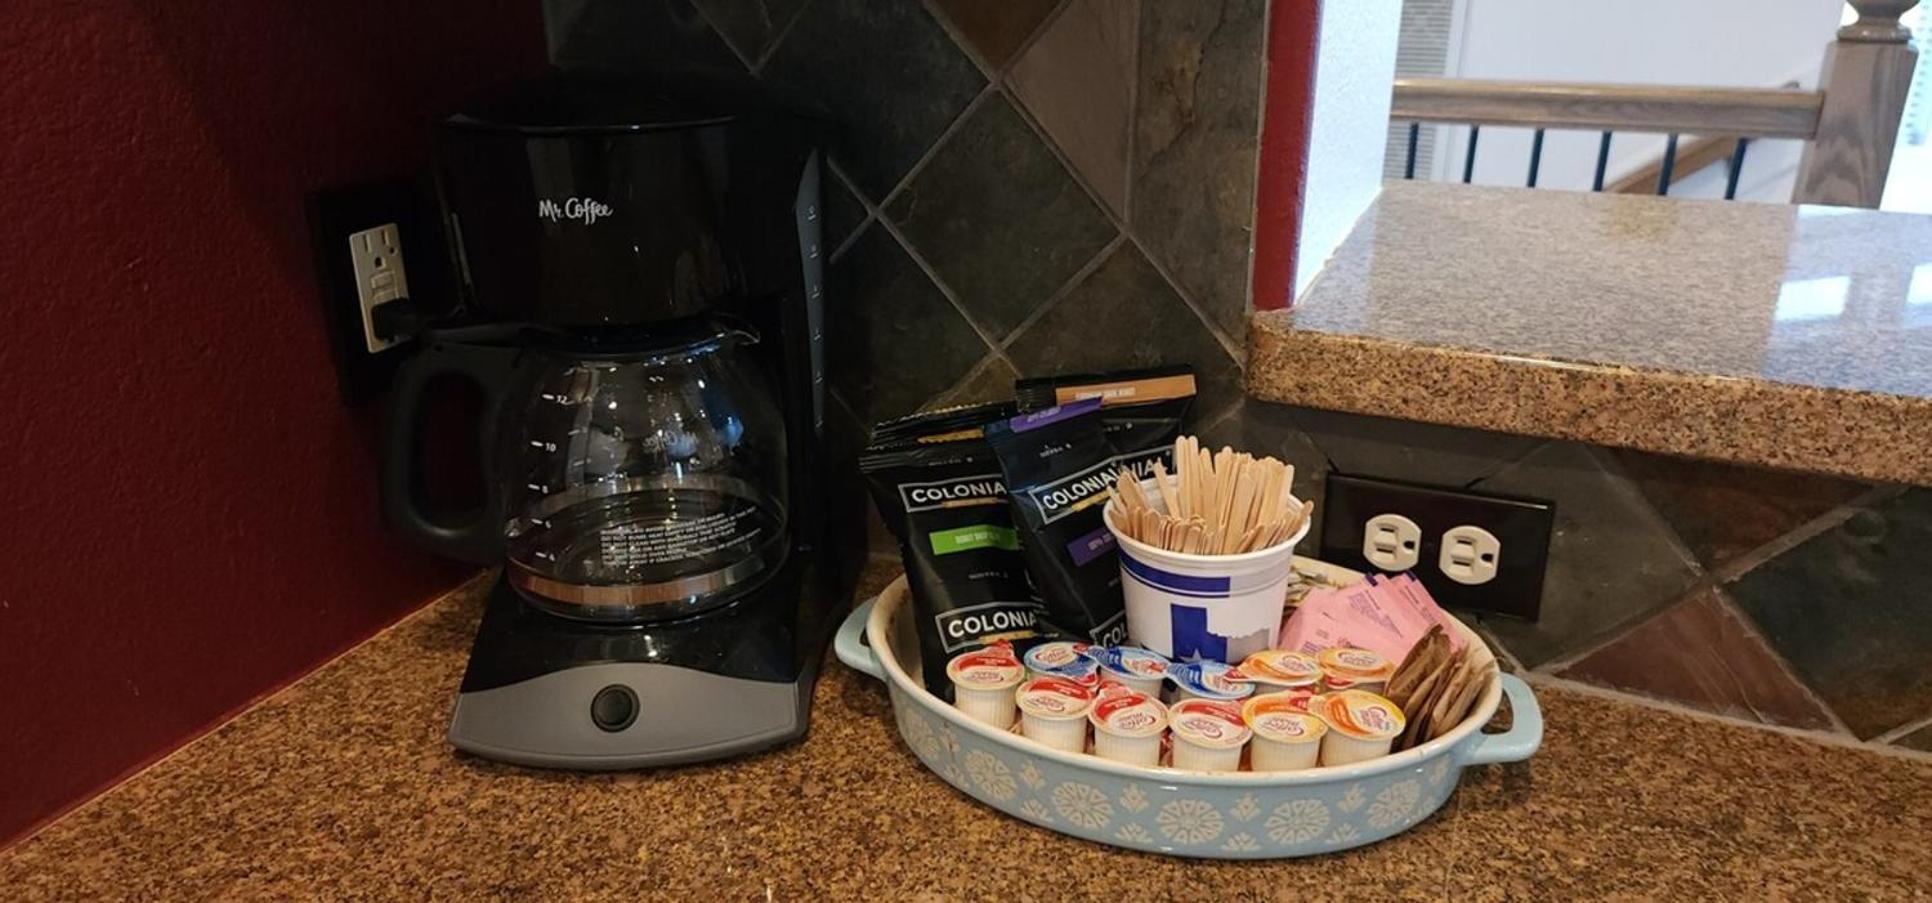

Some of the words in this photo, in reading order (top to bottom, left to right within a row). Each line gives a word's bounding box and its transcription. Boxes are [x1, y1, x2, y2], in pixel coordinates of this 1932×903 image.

[539, 199, 564, 223] Mr.
[565, 197, 614, 225] Coffee
[545, 442, 557, 452] 10
[911, 481, 1008, 502] COLONIA
[948, 610, 1037, 638] COLONIA
